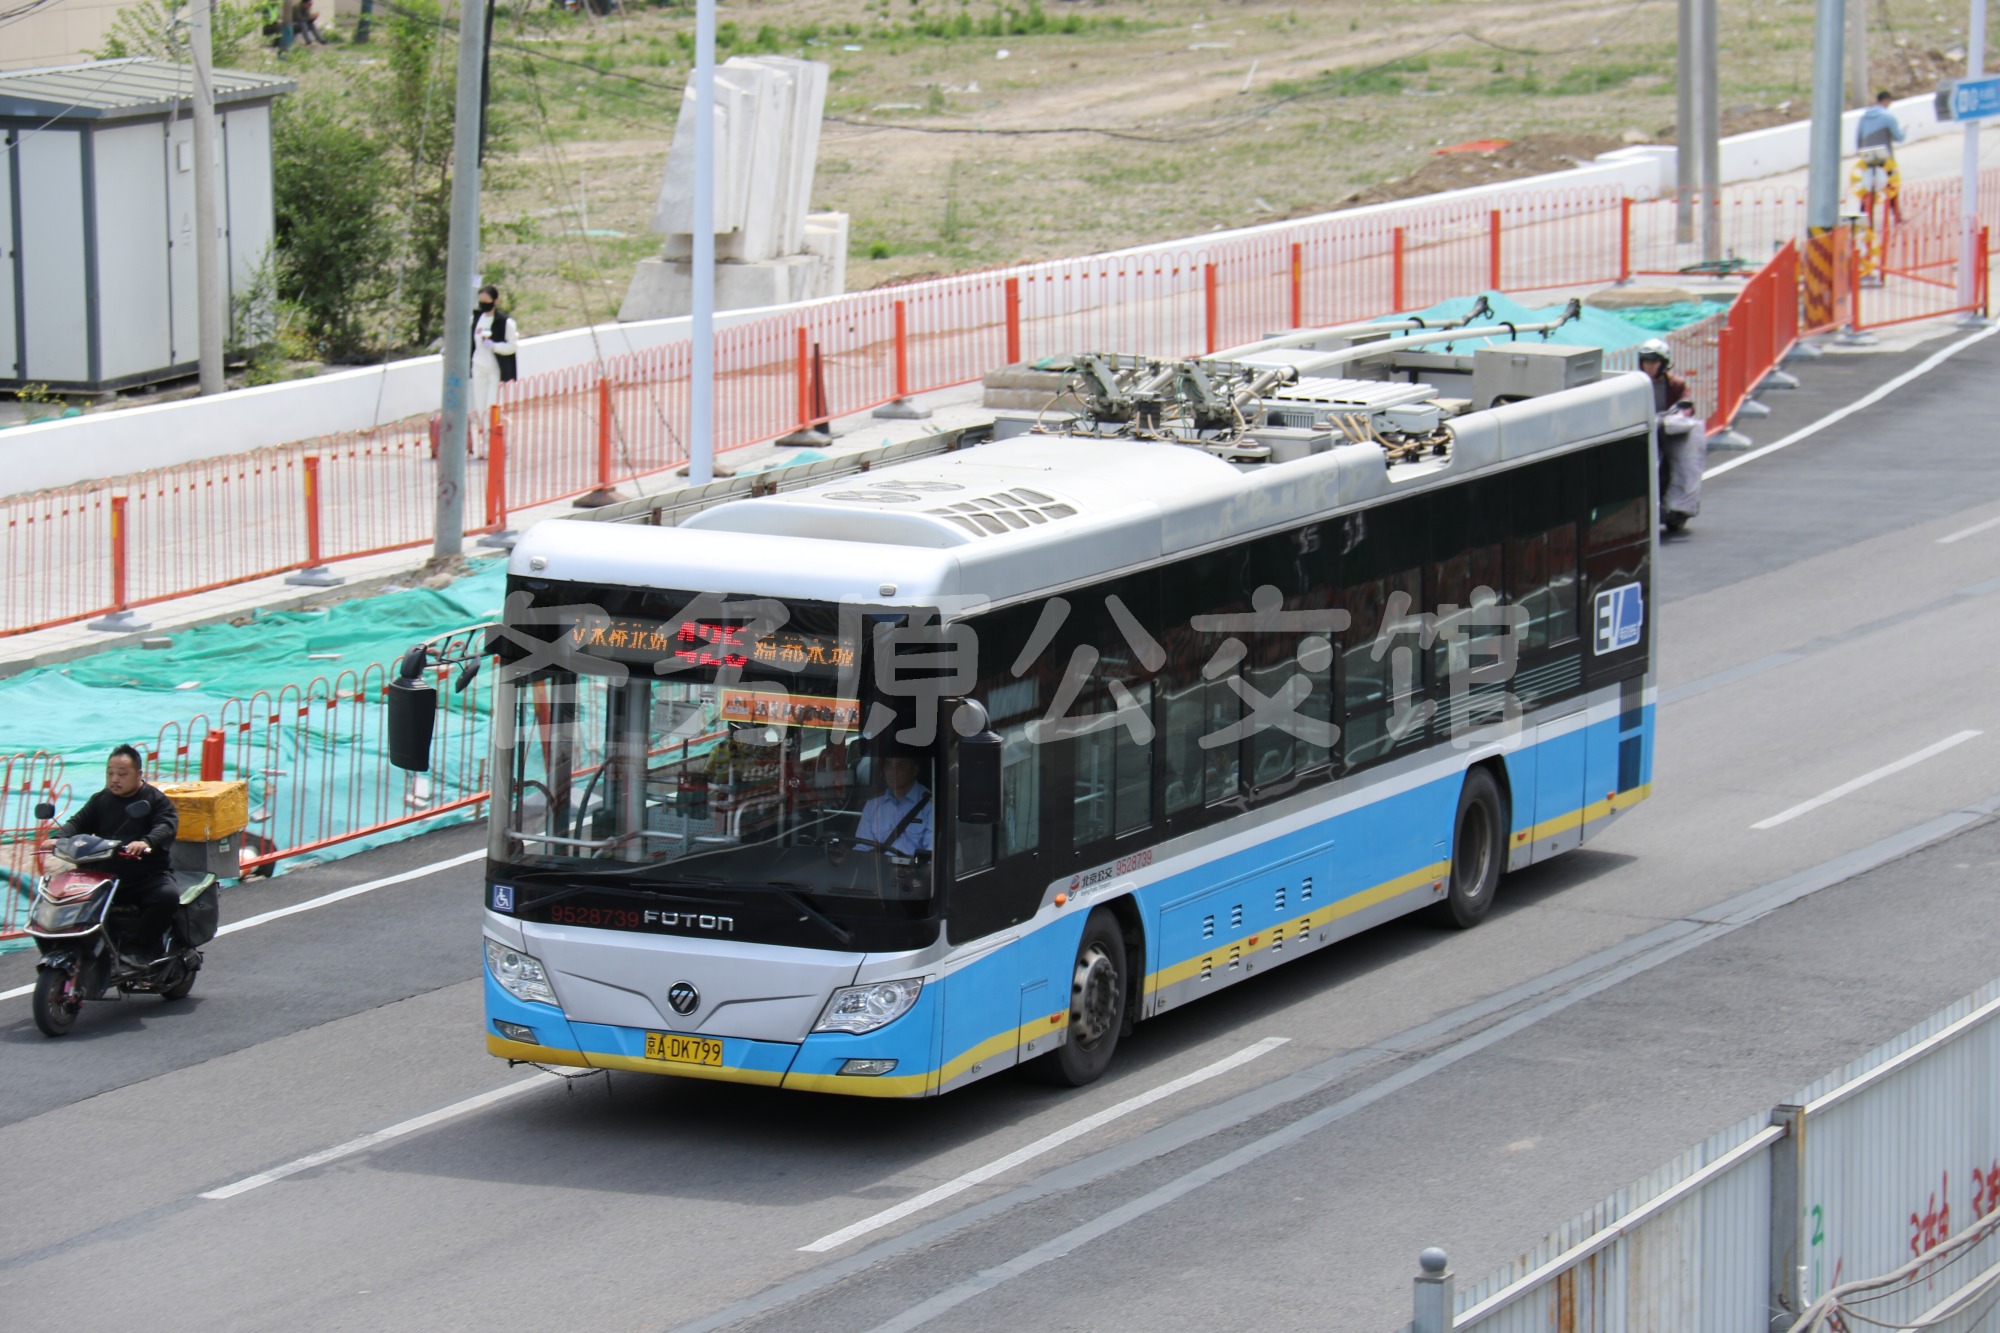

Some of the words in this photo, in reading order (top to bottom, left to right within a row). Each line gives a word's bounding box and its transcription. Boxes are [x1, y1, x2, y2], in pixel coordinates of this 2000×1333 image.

[1116, 850, 1152, 876] 9528739
[1082, 867, 1113, 888] 北京公交
[551, 905, 640, 928] 9528739
[644, 910, 734, 931] FOTON
